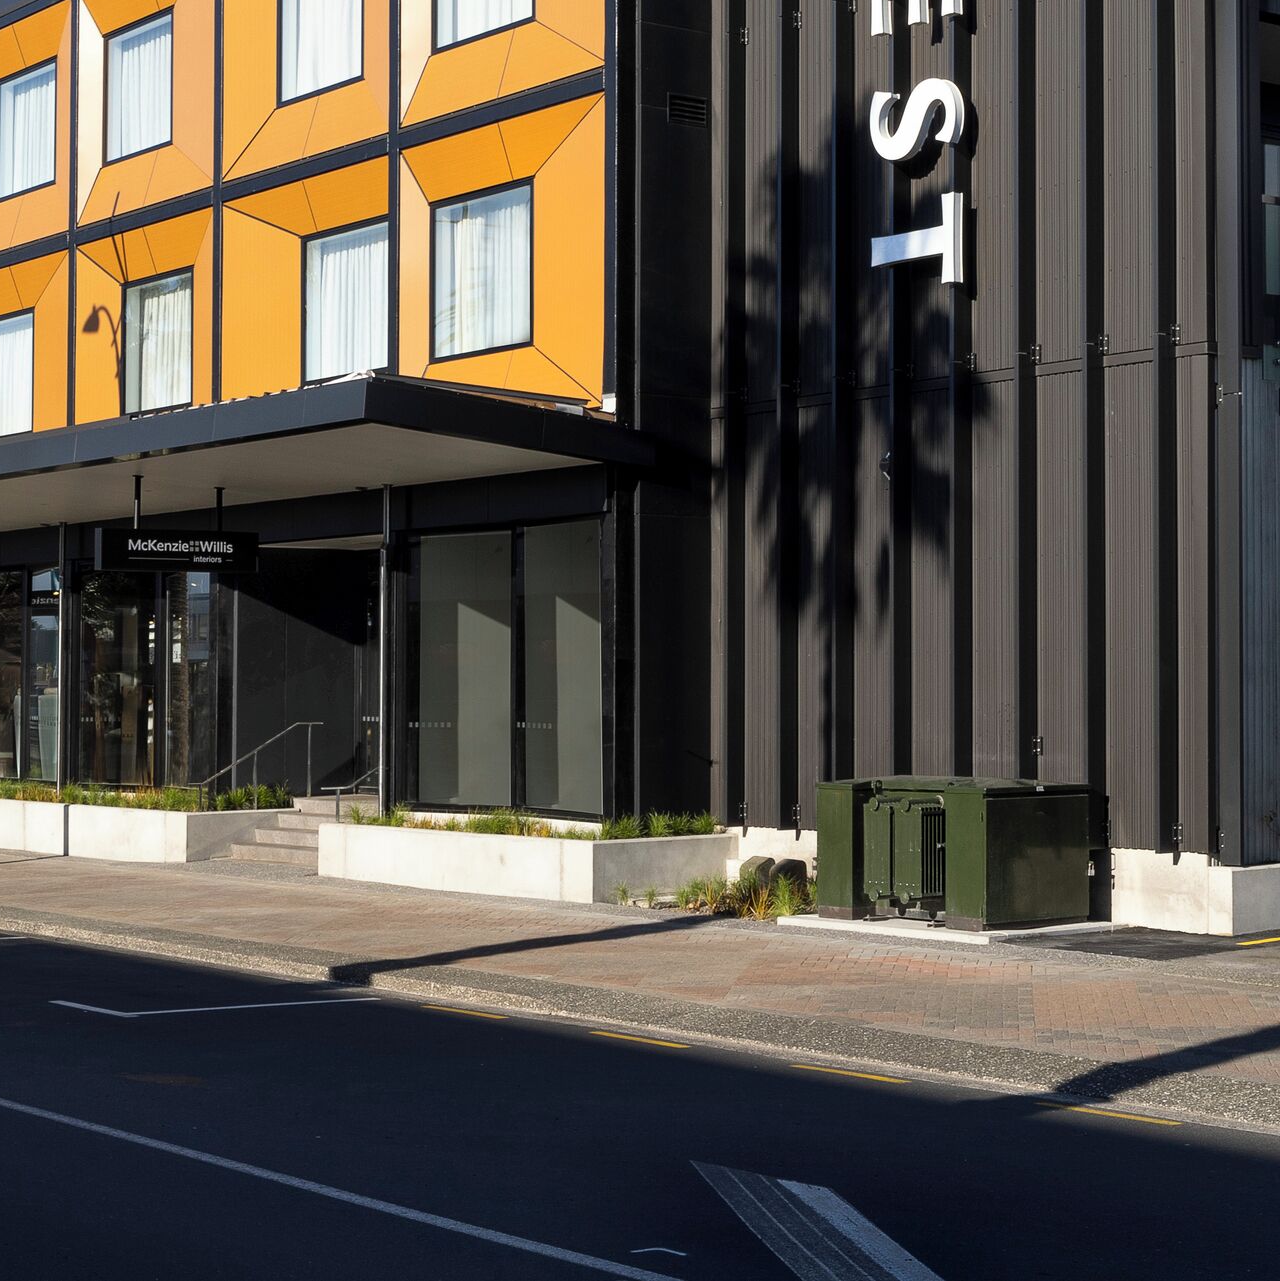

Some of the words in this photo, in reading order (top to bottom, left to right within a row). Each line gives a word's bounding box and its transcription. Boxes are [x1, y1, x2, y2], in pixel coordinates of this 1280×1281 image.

[127, 539, 189, 552] McKenzie
[199, 540, 234, 553] Willis
[193, 555, 222, 563] interiors
